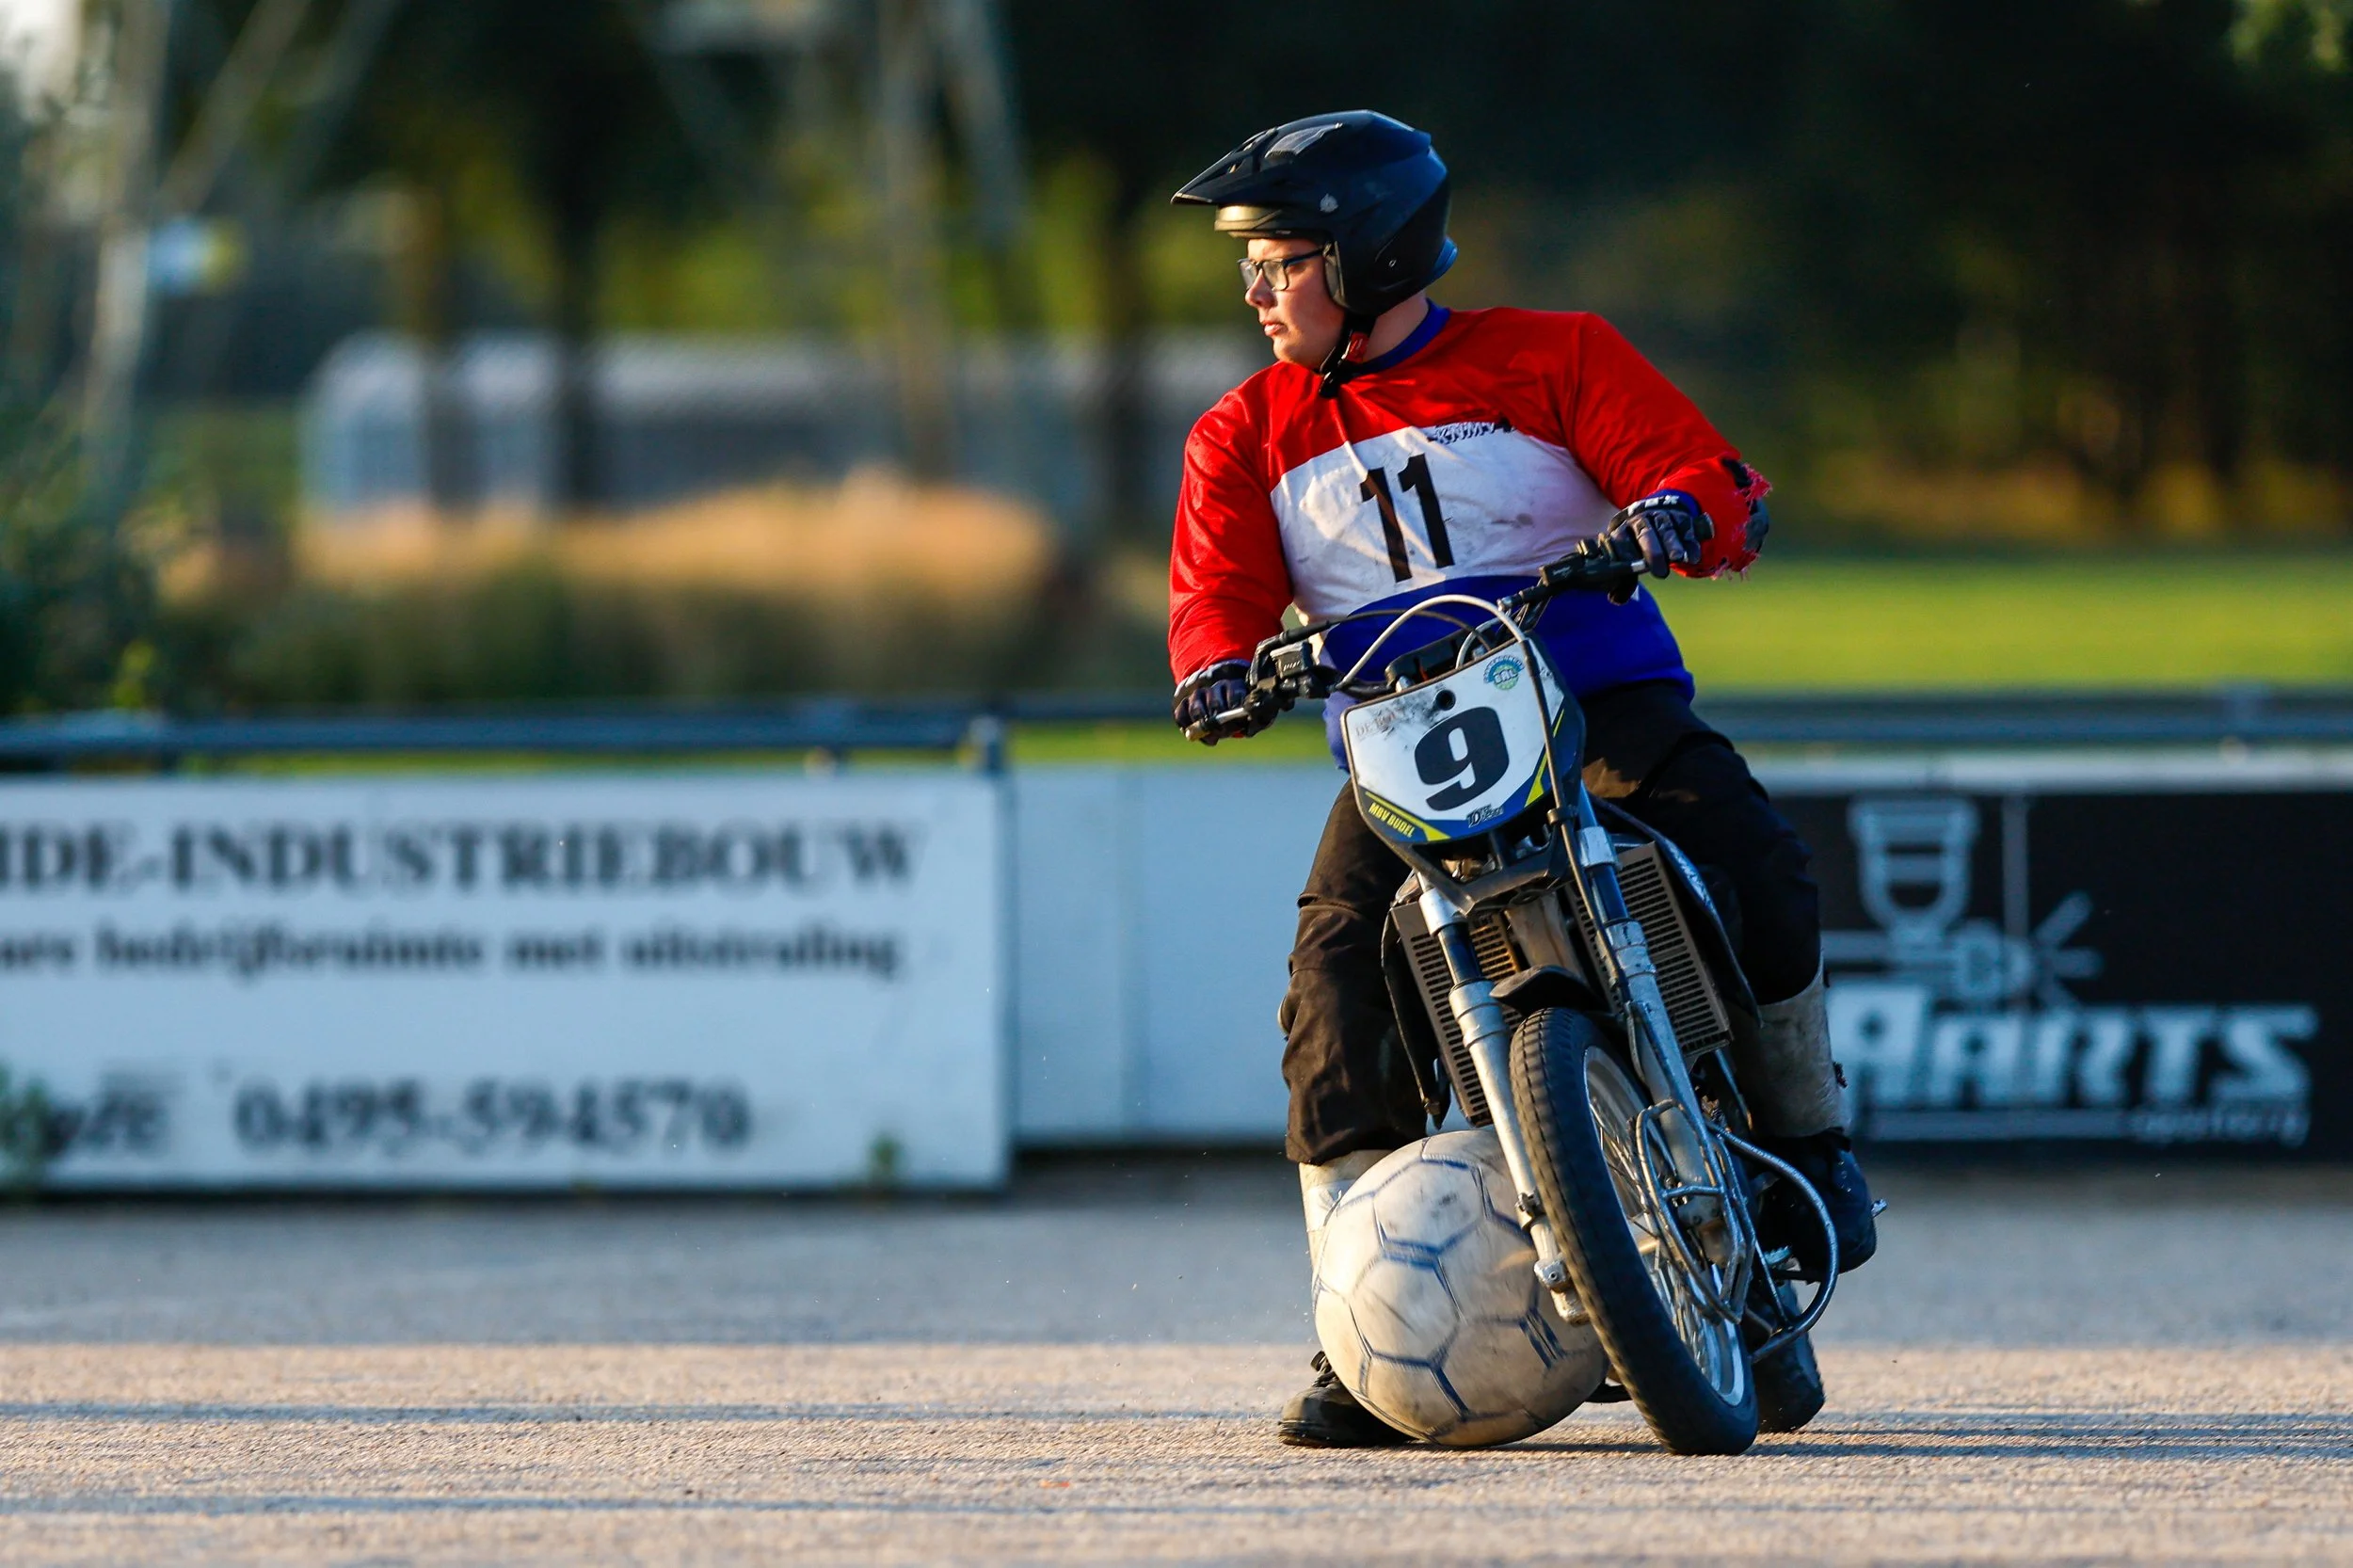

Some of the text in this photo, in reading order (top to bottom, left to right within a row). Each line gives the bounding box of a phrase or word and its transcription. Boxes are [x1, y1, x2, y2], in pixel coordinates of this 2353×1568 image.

[1359, 454, 1455, 583] 11
[1415, 706, 1510, 811] 9
[1369, 802, 1416, 838] MBV BUDEL
